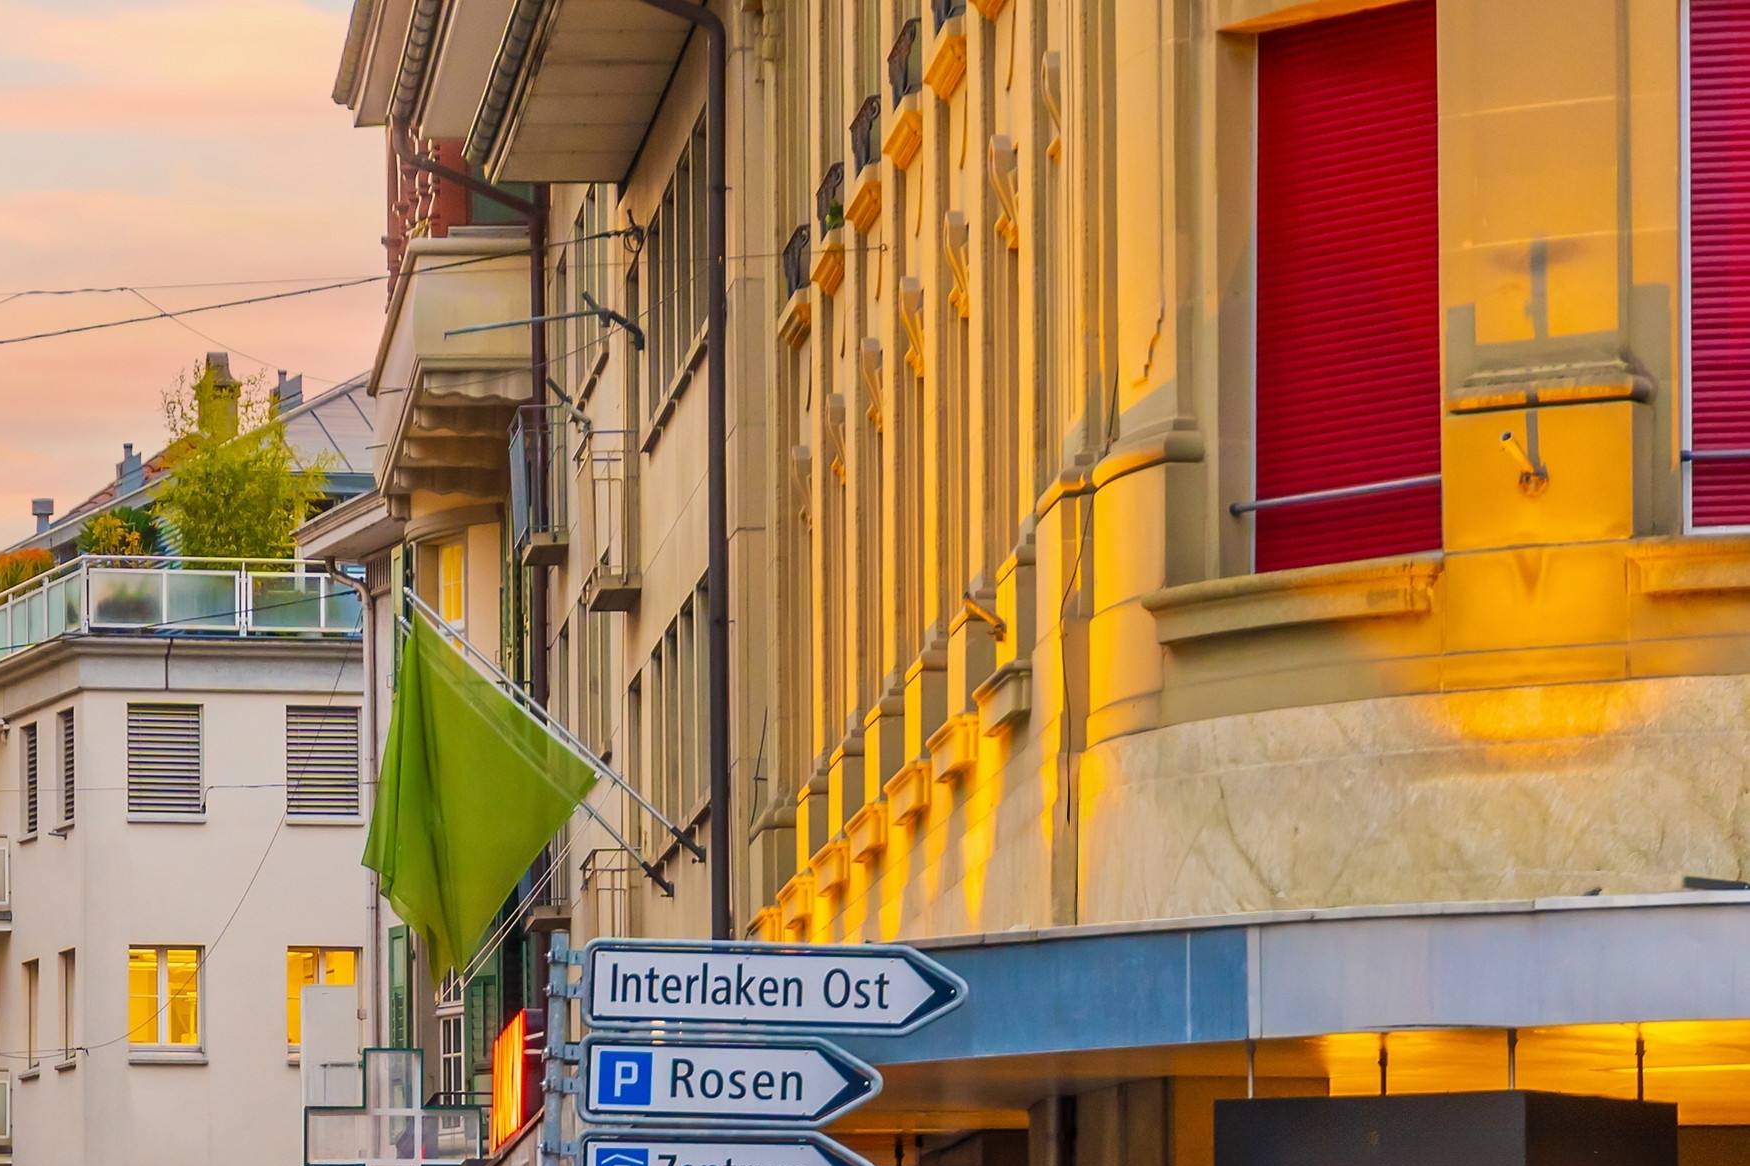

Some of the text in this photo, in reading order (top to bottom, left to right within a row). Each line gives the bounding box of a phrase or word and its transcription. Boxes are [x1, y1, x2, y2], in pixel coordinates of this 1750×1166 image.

[609, 961, 891, 1011] Interlaken Ost
[613, 1057, 804, 1102] P Rosen
